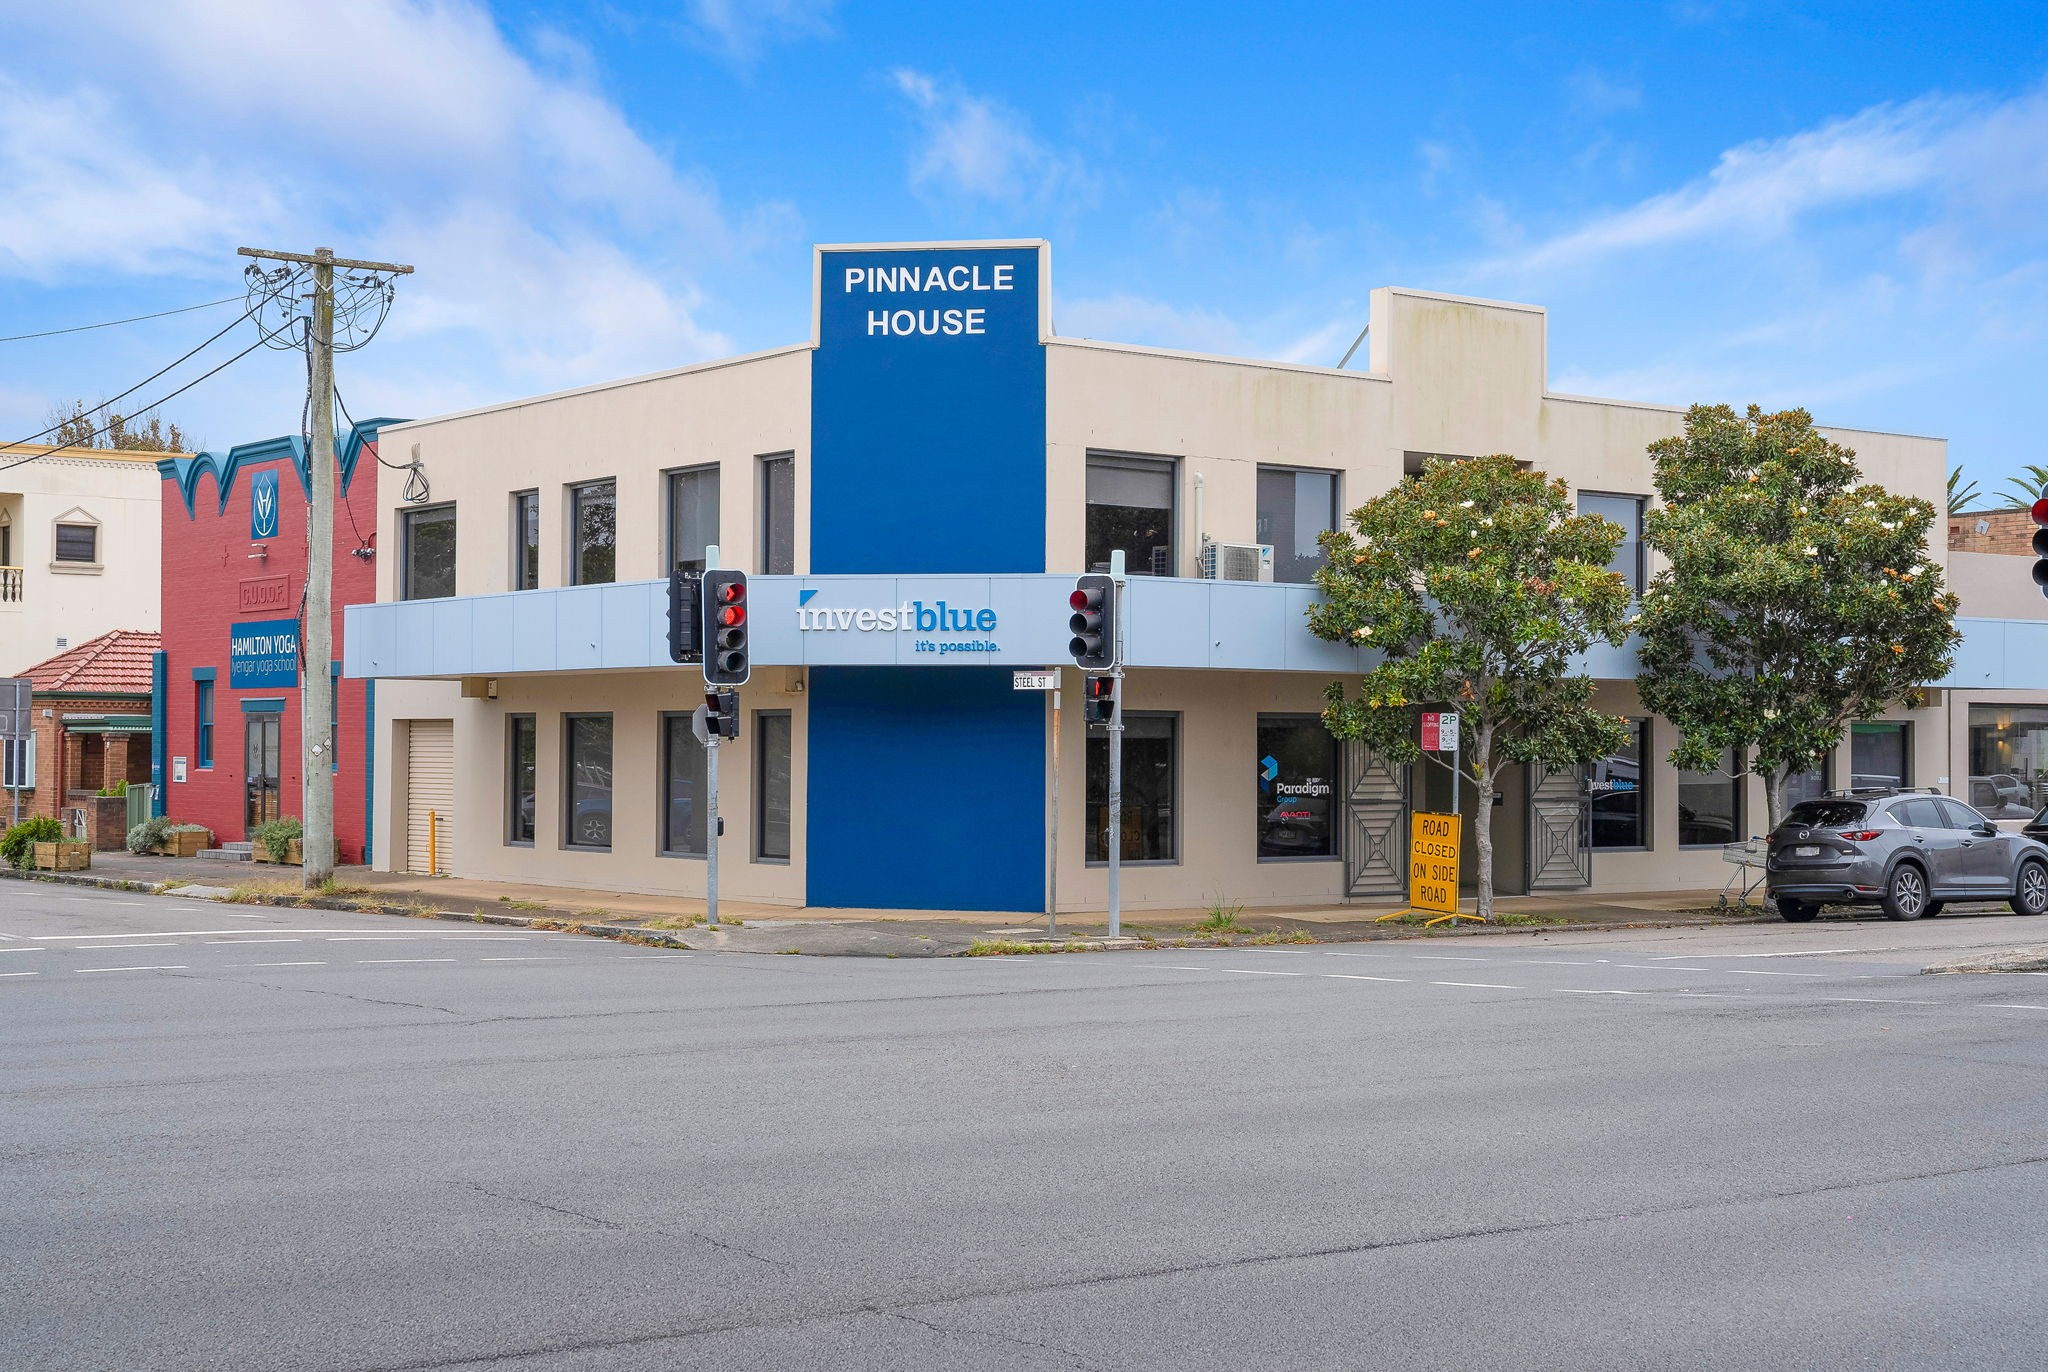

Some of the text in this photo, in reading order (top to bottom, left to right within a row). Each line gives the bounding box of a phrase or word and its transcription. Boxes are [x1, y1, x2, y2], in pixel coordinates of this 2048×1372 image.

[845, 265, 1014, 293] PINNACLE
[867, 309, 986, 336] HOUSE
[796, 590, 996, 632] investblue
[231, 634, 297, 656] HAMILTON YOGA
[939, 640, 1001, 655] possible.
[256, 659, 273, 676] yoga
[274, 654, 297, 672] school
[1014, 677, 1046, 688] STEEL ST
[1441, 716, 1457, 724] 2P
[1276, 782, 1330, 797] Paradigm
[1276, 795, 1297, 804] Group
[1422, 819, 1449, 837] ROAD
[1414, 841, 1456, 859] CLOSED
[1413, 863, 1455, 882] ON SIDE
[1420, 885, 1447, 903] ROAD
